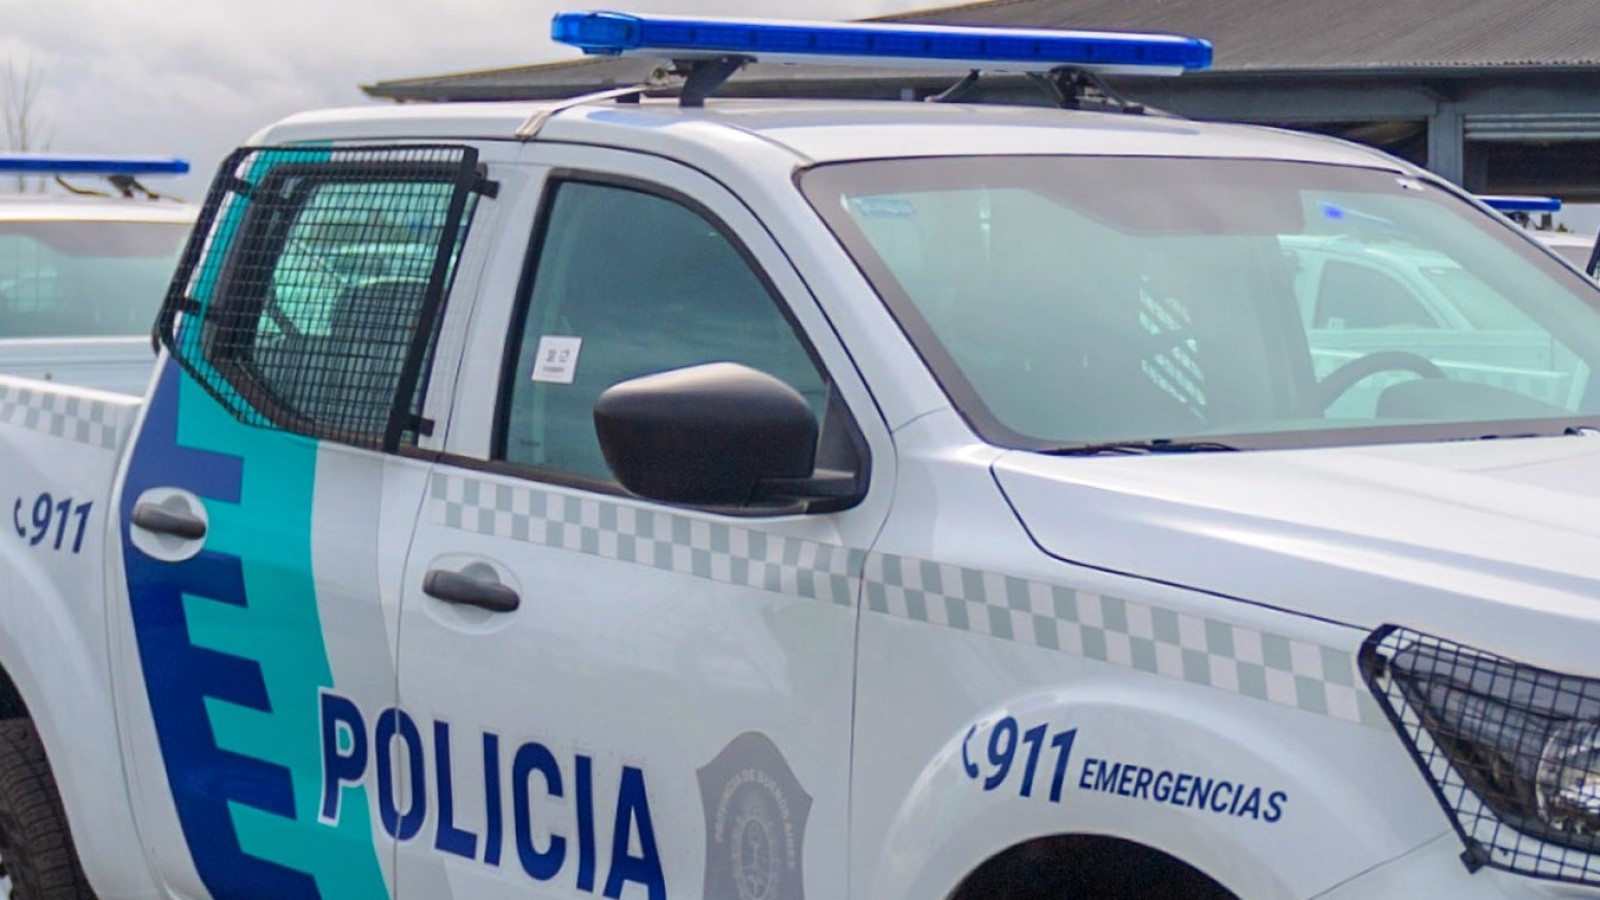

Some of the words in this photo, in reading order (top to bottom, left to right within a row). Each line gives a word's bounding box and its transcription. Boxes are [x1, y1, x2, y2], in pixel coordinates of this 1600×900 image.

[30, 492, 93, 554] 911
[319, 689, 667, 900] POLICIA
[983, 715, 1078, 803] 911
[1079, 758, 1288, 823] EMERGENCIAS
